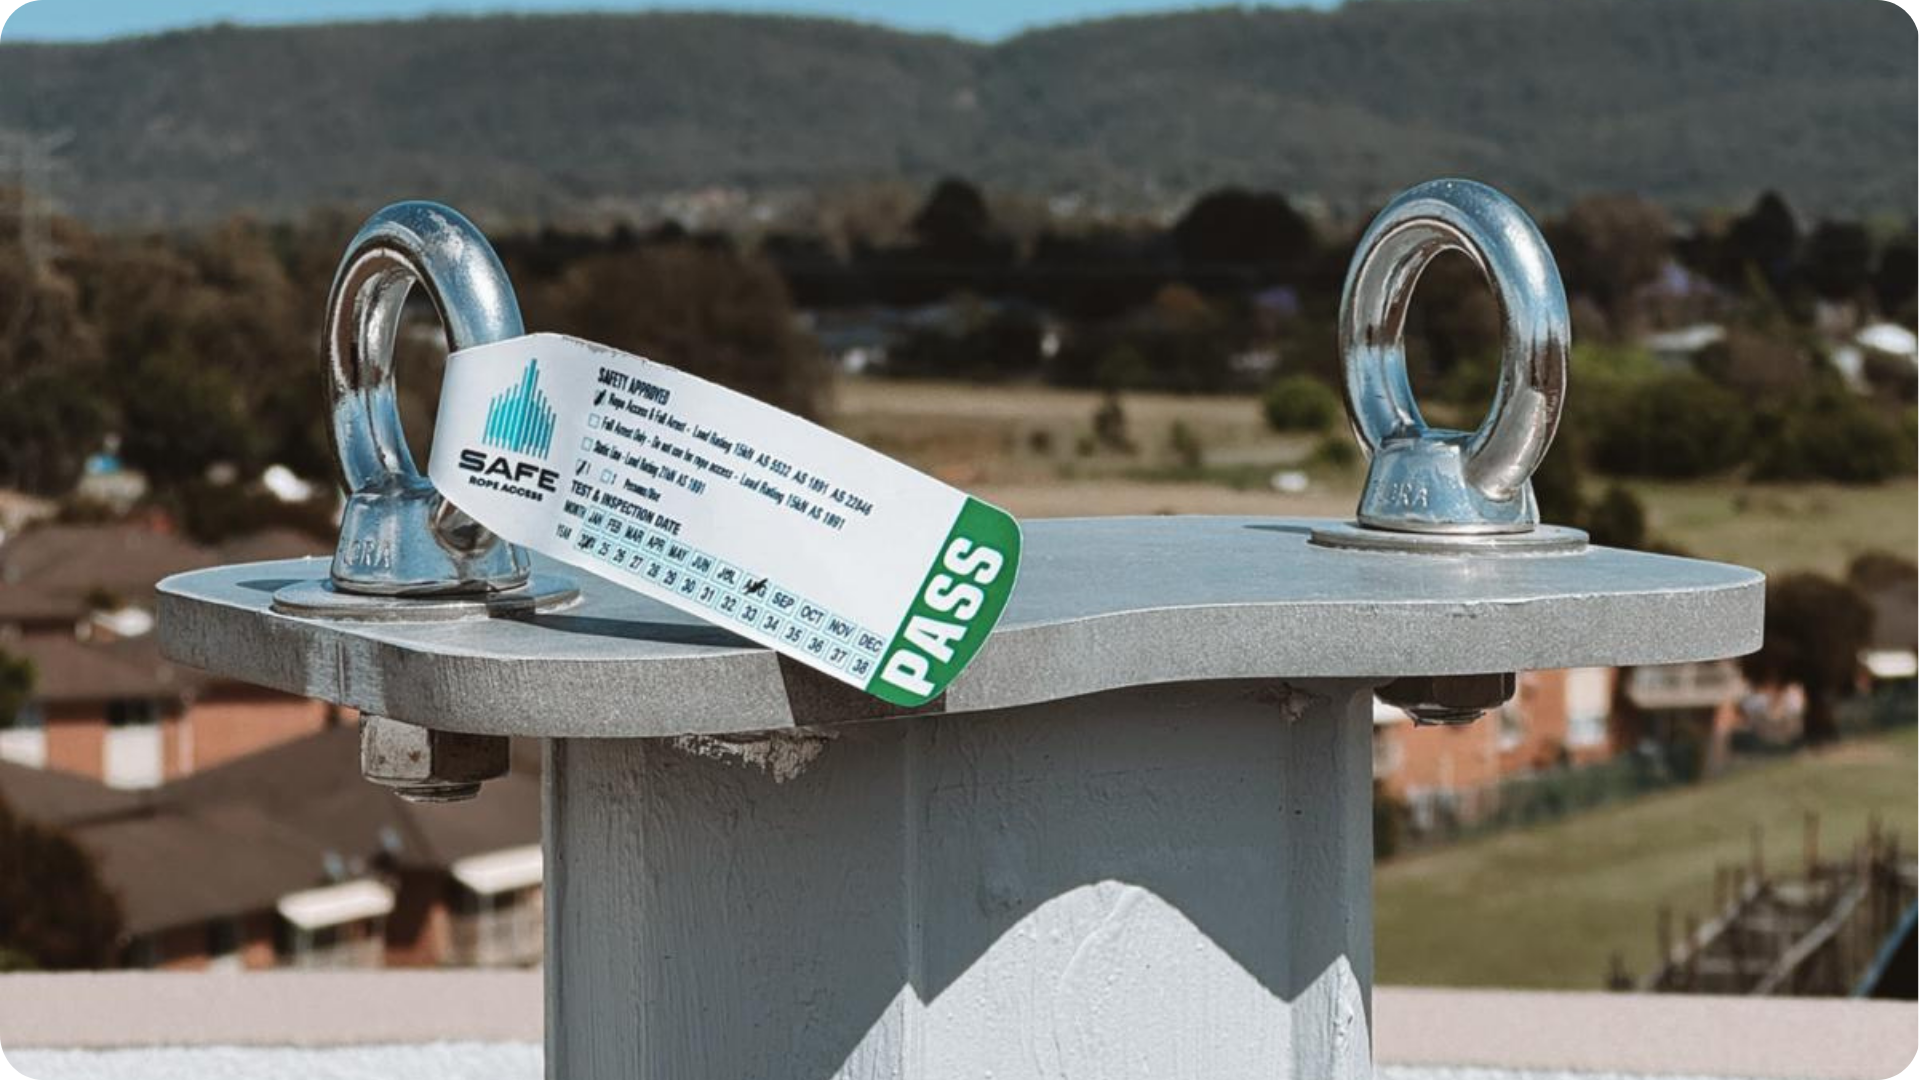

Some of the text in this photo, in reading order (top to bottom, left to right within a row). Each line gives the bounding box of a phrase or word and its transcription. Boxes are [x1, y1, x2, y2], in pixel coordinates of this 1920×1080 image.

[599, 366, 670, 404] SAFETY APPROVED
[459, 448, 559, 492] SAFE
[470, 475, 543, 501] ROPE ACCESS
[602, 416, 614, 430] Fall
[615, 421, 633, 437] Arrest
[634, 428, 647, 446] Only
[652, 435, 661, 448] Do
[662, 442, 672, 453] not
[684, 448, 694, 461] for
[694, 456, 708, 469] rope
[709, 462, 733, 478] access
[741, 472, 761, 490] Load
[760, 481, 784, 504] Rating
[786, 493, 809, 513] 15kN
[808, 505, 823, 519] AS
[610, 392, 625, 409] Rope
[627, 399, 648, 416] Access
[656, 410, 667, 424] Fall
[668, 415, 686, 432] Arrest
[693, 424, 711, 441] Load
[710, 432, 732, 453] Rating
[734, 442, 754, 459] 15kN
[756, 453, 770, 466] AS
[793, 470, 807, 484] AS
[831, 488, 845, 503] AS
[845, 494, 873, 515] 22846
[625, 452, 641, 467] Load
[640, 456, 659, 478] Rating
[677, 473, 689, 486] AS
[572, 479, 681, 535] TEST & INSPECTION DATE
[555, 522, 572, 539] YEAR
[599, 541, 611, 556] 25
[613, 548, 626, 563] 26
[630, 554, 643, 569] 27
[648, 561, 660, 578] 28
[664, 569, 677, 585] 29
[682, 577, 696, 593] 30
[700, 586, 715, 601] 31
[721, 595, 736, 611] 32
[742, 605, 757, 621] 33
[763, 616, 779, 632] 34
[785, 626, 801, 643] 35
[808, 637, 824, 654] 36
[830, 648, 847, 663] 37
[852, 658, 869, 676] 38
[564, 499, 586, 519] MONTH
[589, 511, 602, 525] JAN
[606, 517, 622, 533] FEB
[626, 525, 644, 542] MAR
[647, 535, 666, 551] APR
[669, 544, 688, 561] MAY
[692, 556, 711, 572] JUN
[744, 578, 767, 597] AG
[772, 591, 795, 608] SEP
[801, 605, 824, 623] OCT
[828, 618, 854, 637] NOV
[859, 633, 883, 653] DEC
[881, 536, 1003, 697] PASS
